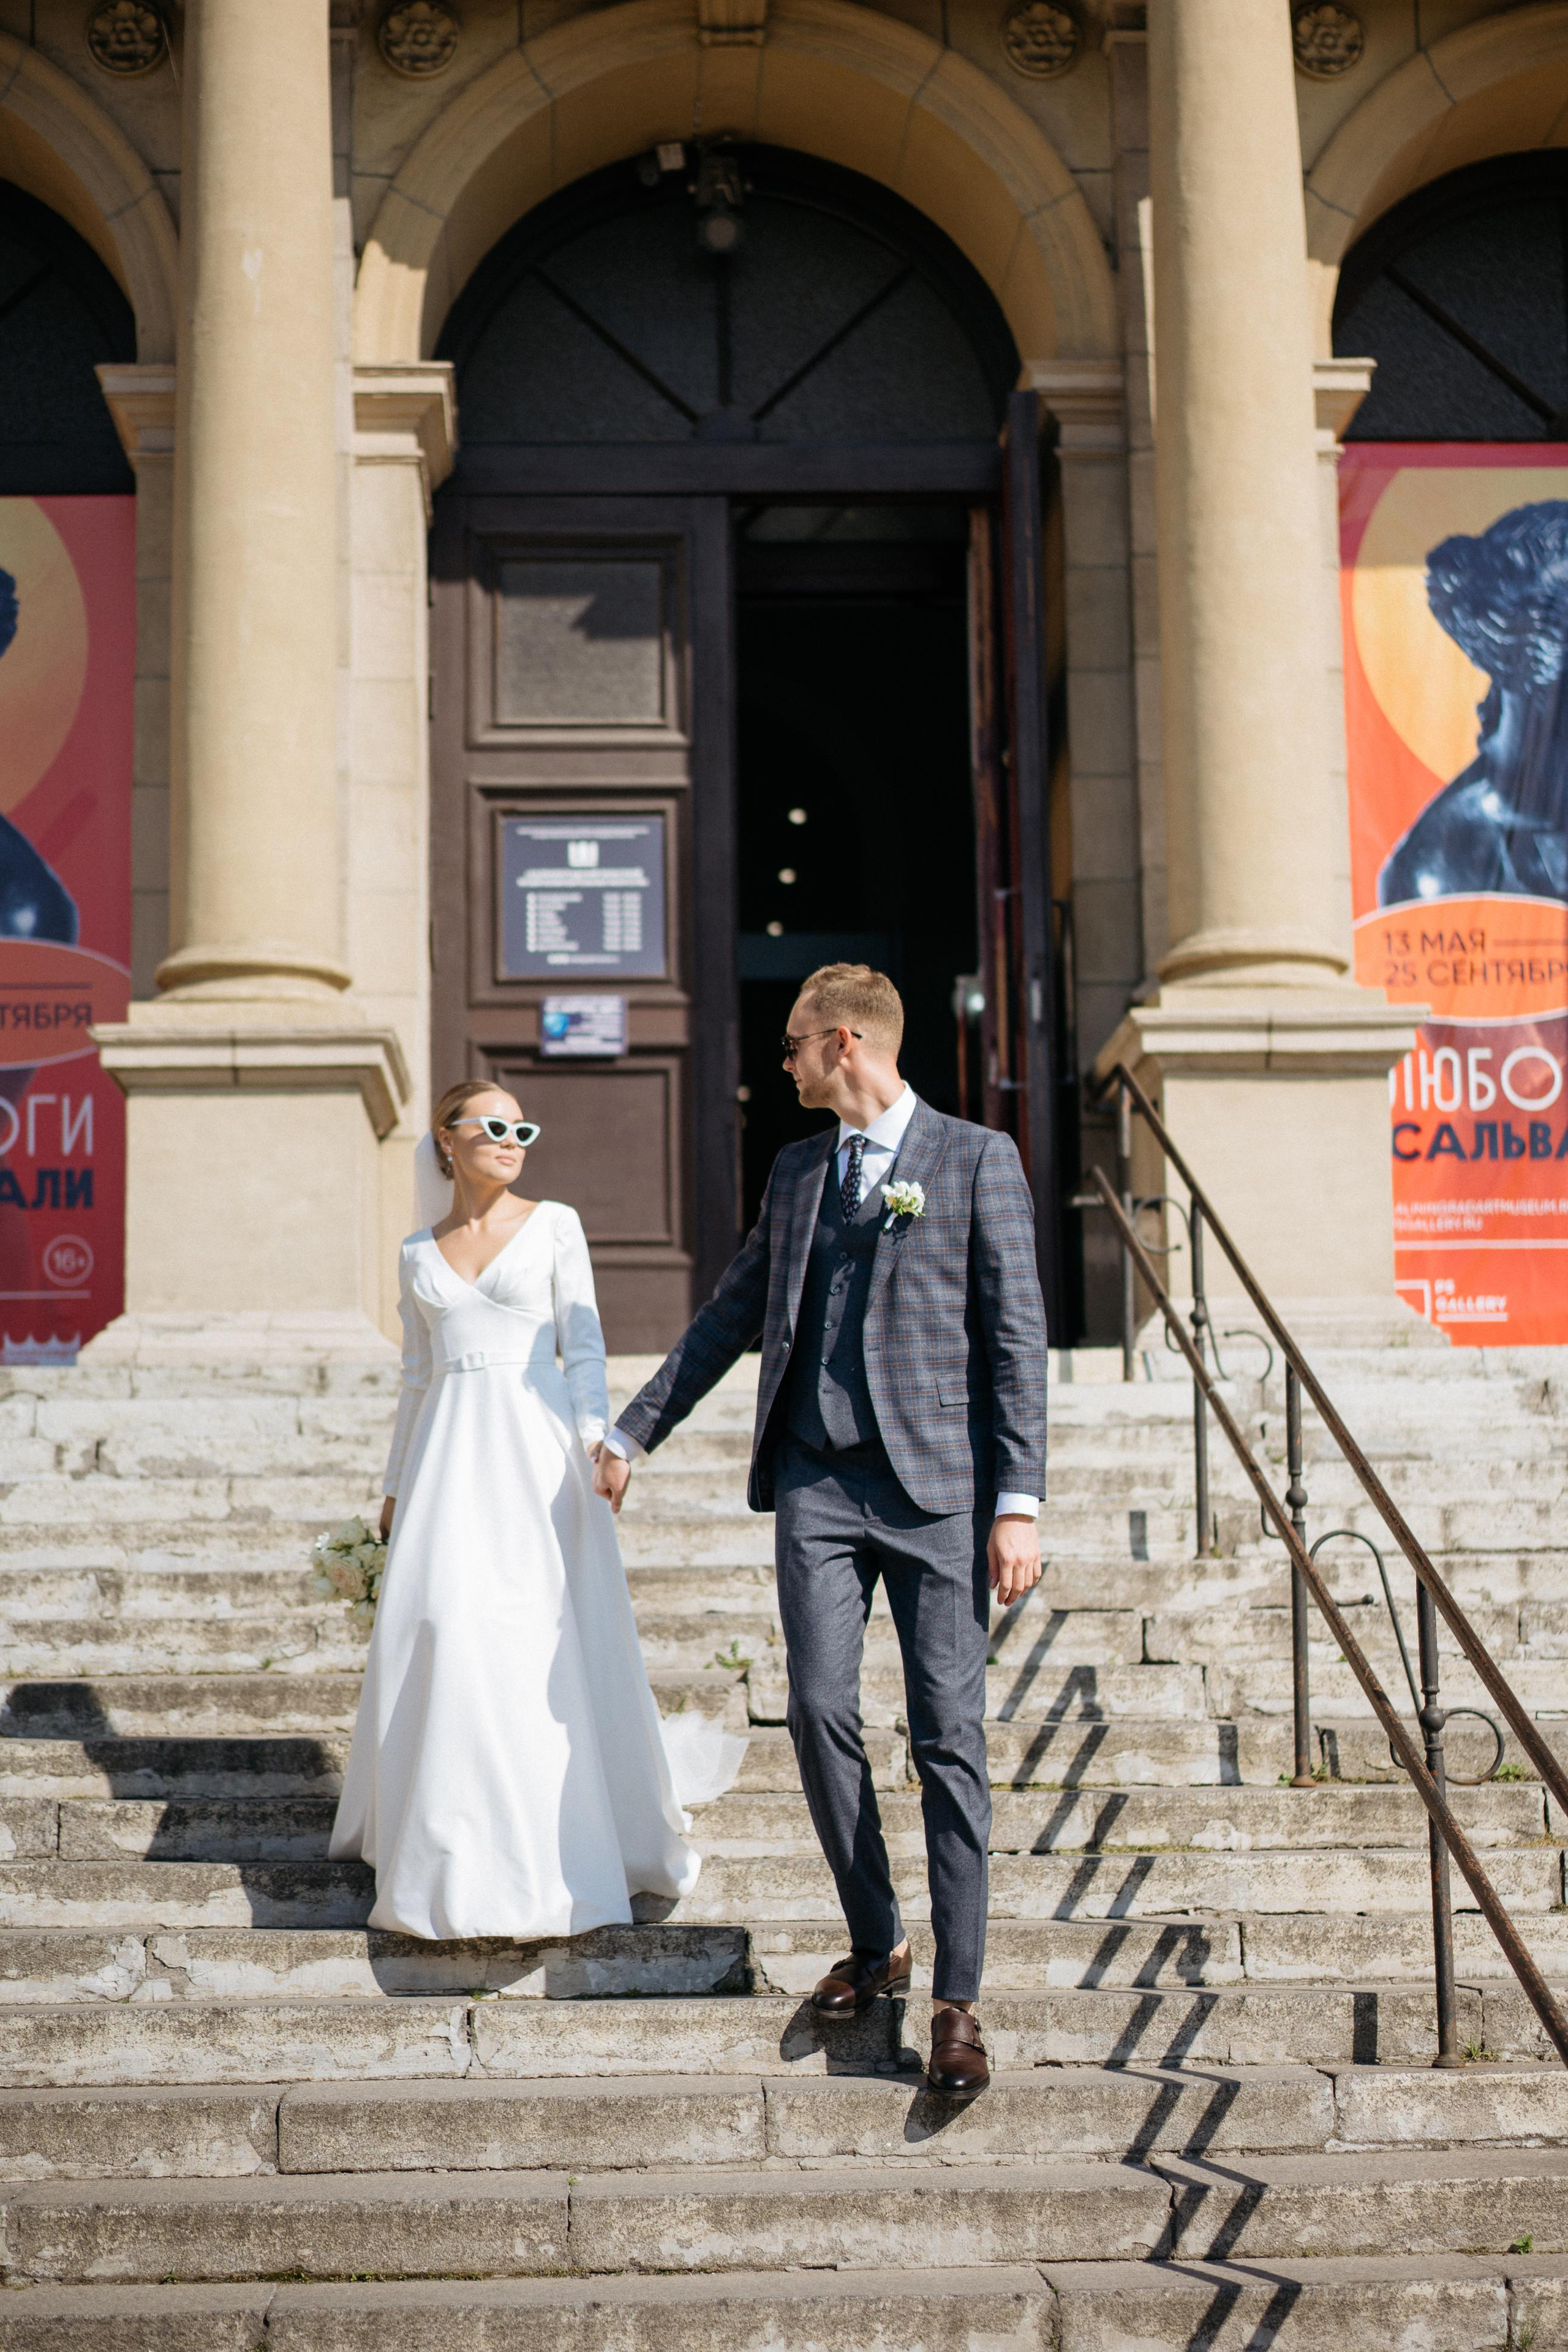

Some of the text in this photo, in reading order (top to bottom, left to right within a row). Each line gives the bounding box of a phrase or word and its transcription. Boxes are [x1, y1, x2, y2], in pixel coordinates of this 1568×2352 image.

[1385, 929, 1485, 955] 13 МАЯ
[1385, 957, 1568, 986] 25 СЕНТЯБР
[1436, 1295, 1507, 1311] GALLERY
